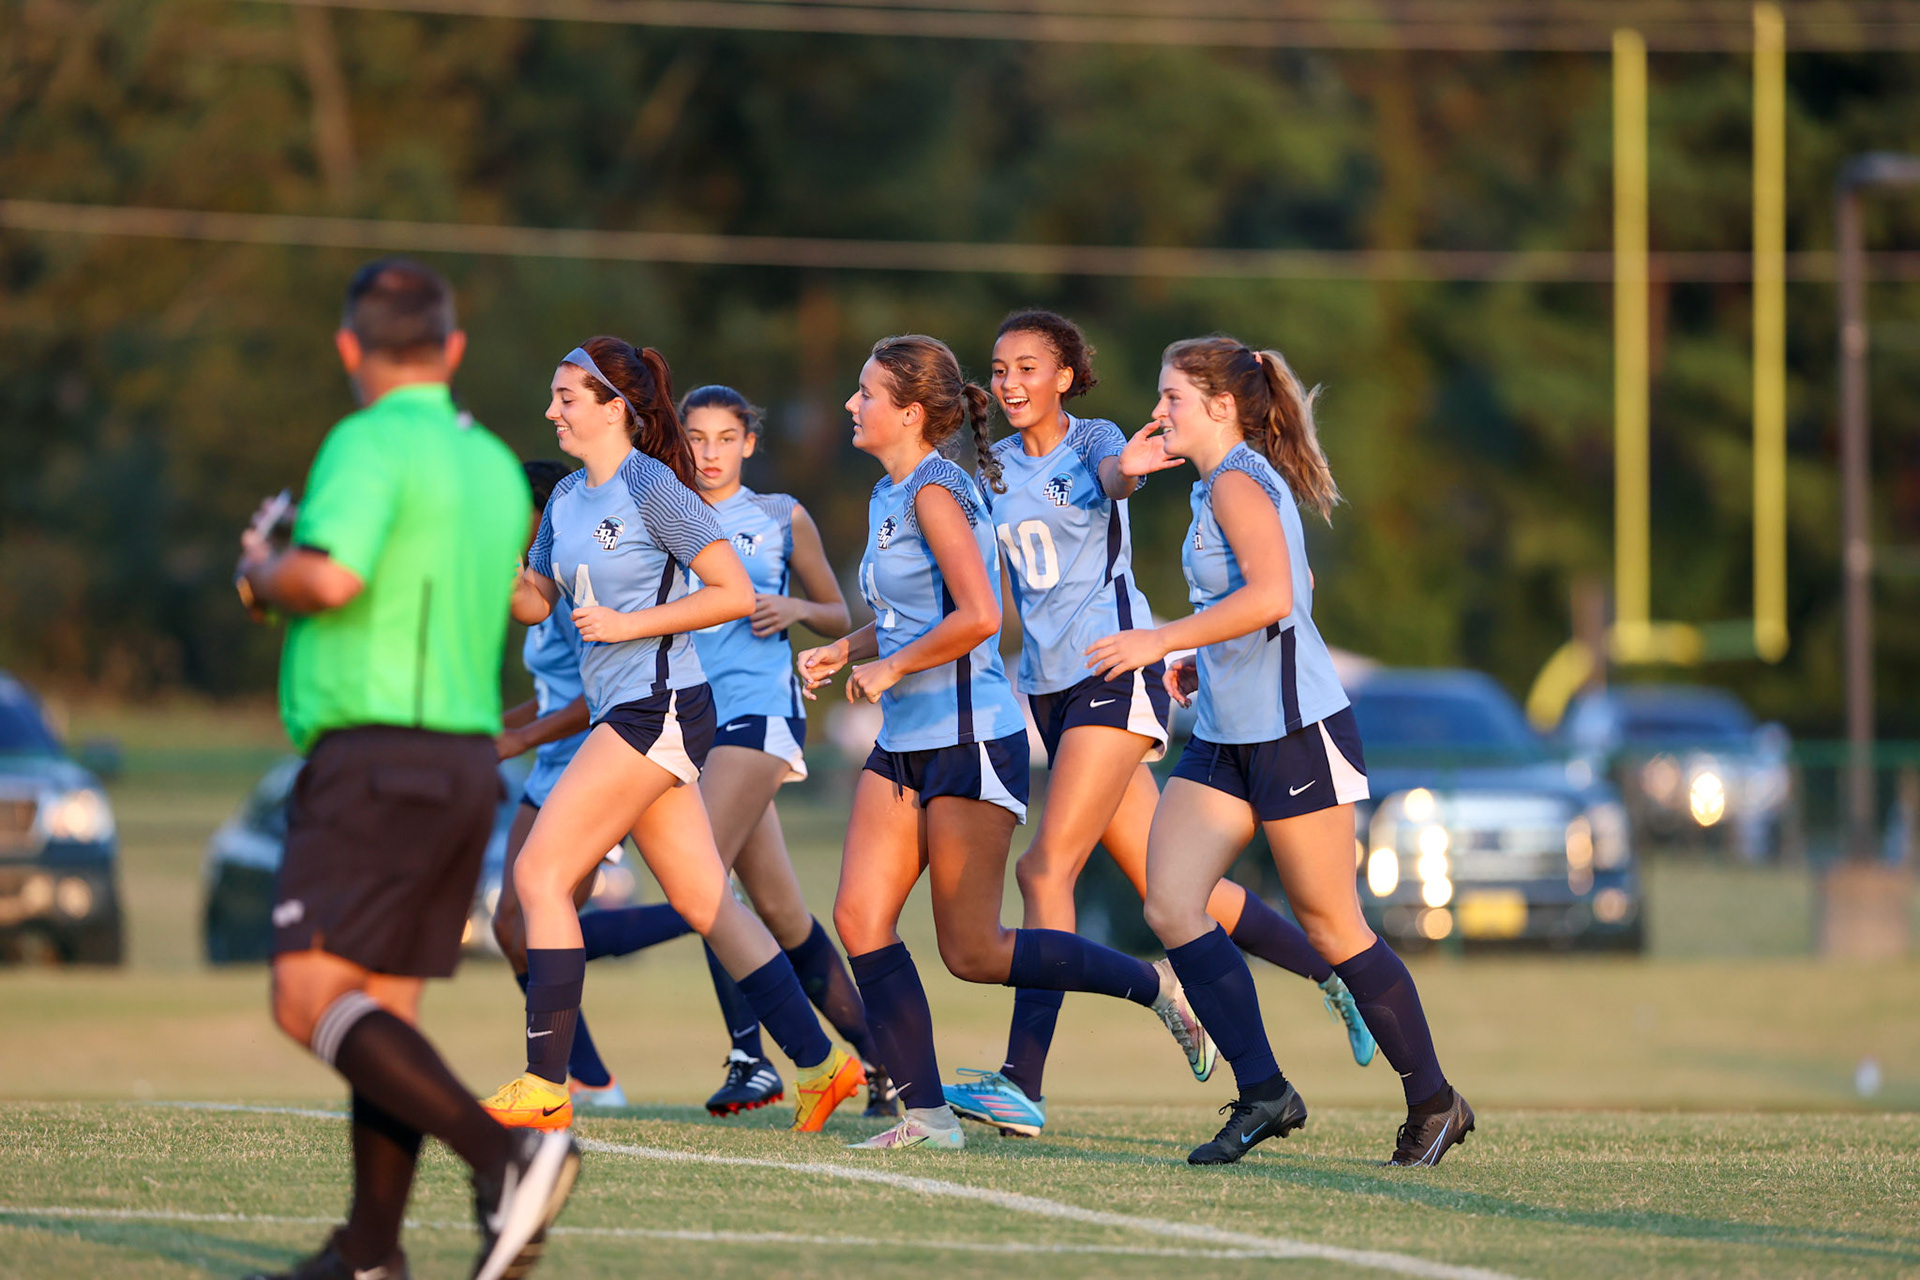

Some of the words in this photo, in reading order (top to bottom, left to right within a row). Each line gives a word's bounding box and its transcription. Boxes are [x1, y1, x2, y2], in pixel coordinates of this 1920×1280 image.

[1043, 479, 1070, 507] SBA
[593, 522, 619, 551] SBA
[997, 519, 1060, 589] 10
